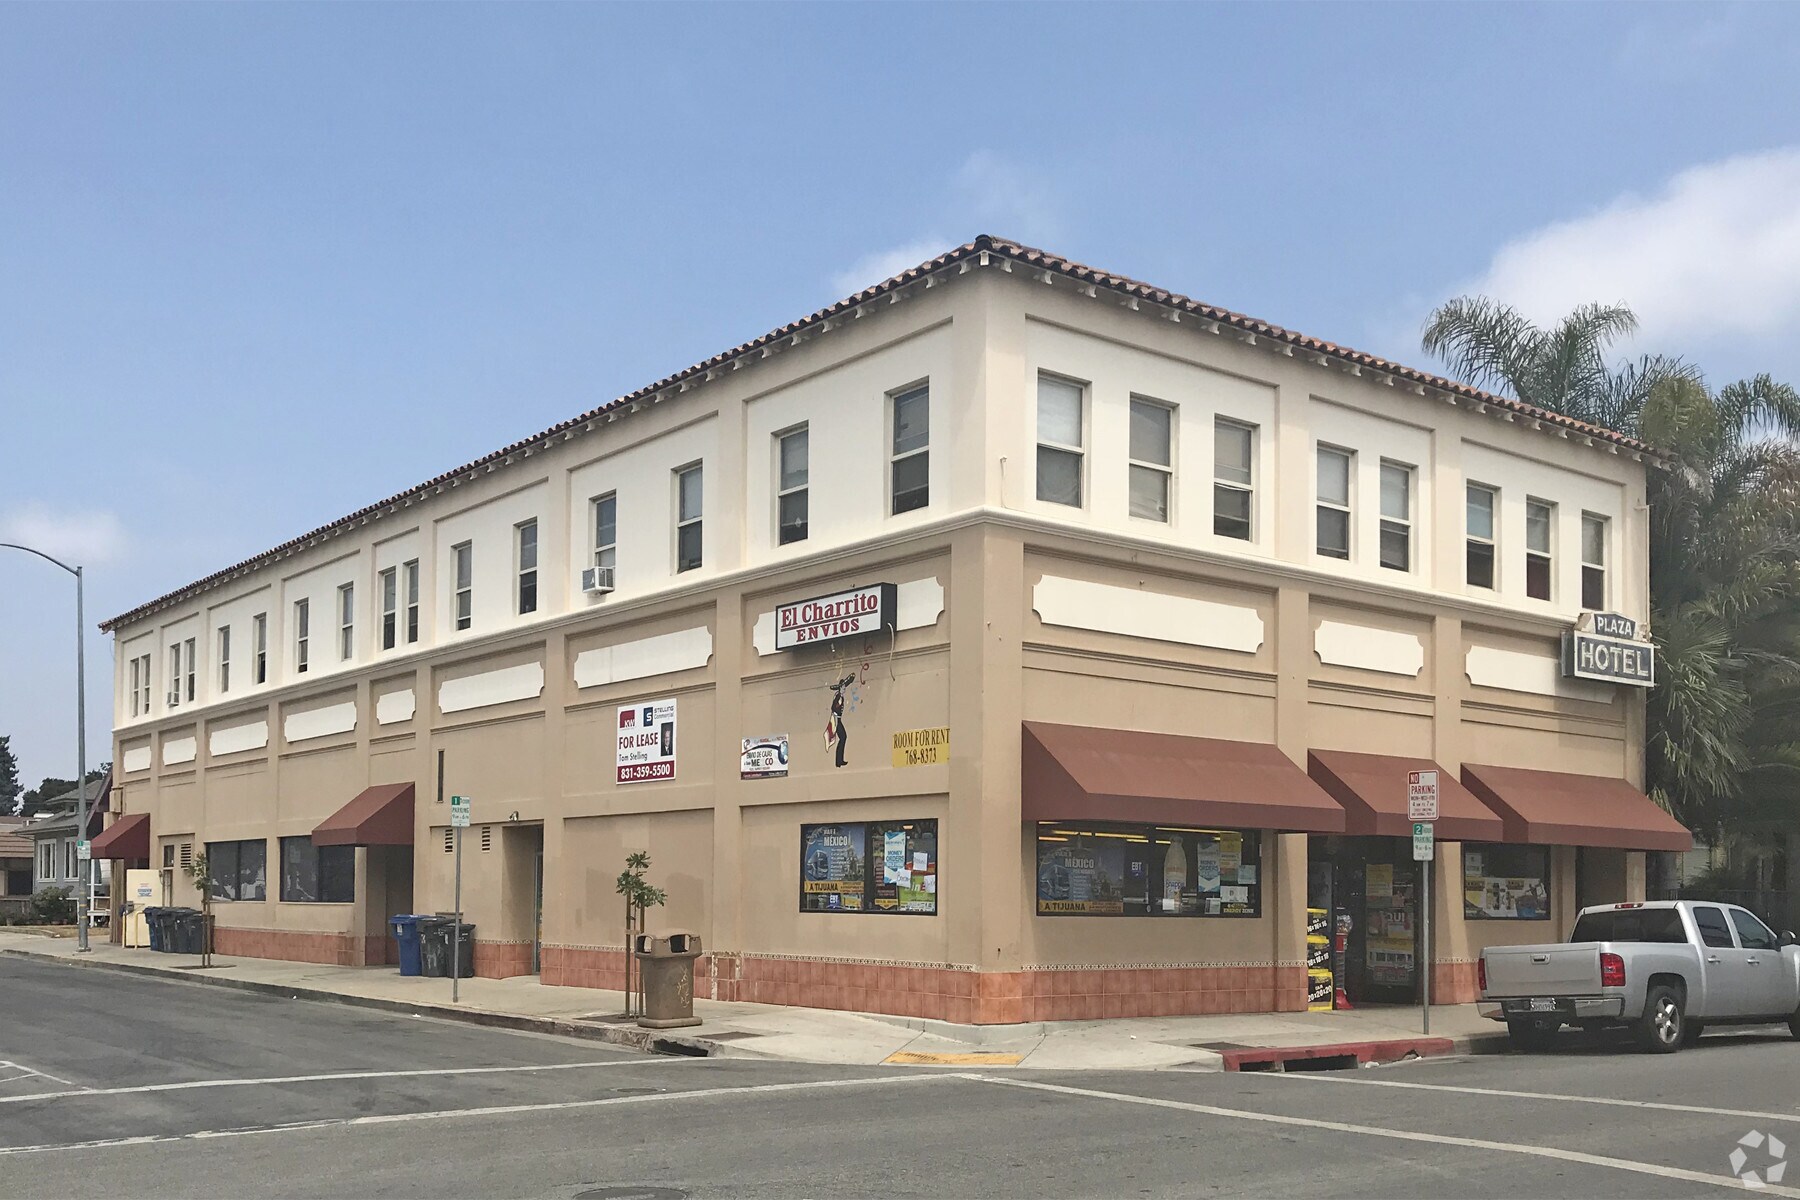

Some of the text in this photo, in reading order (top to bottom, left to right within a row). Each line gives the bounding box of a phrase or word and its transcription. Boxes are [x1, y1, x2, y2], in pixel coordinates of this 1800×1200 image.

[781, 593, 878, 628] El Charrito
[796, 618, 860, 642] ENVIOS
[1597, 616, 1633, 636] PLAZA
[1581, 641, 1649, 677] HOTEL
[654, 705, 674, 714] STELLING
[624, 719, 635, 728] KW
[618, 732, 659, 750] FOR LEASE
[893, 728, 950, 749] ROOM FOR RENT
[619, 751, 648, 762] Tom Stelling
[905, 747, 937, 765] 768-8373
[620, 763, 671, 780] 831-359-5500
[1410, 773, 1419, 784] NO
[1411, 785, 1436, 794] PARKING
[1415, 825, 1421, 834] 2
[823, 834, 848, 847] MÉXICO
[1064, 857, 1095, 869] MÉXICO
[1131, 862, 1142, 871] EBT
[809, 882, 815, 891] A
[815, 881, 839, 892] TIJUANA
[1053, 902, 1086, 911] TIJUANA
